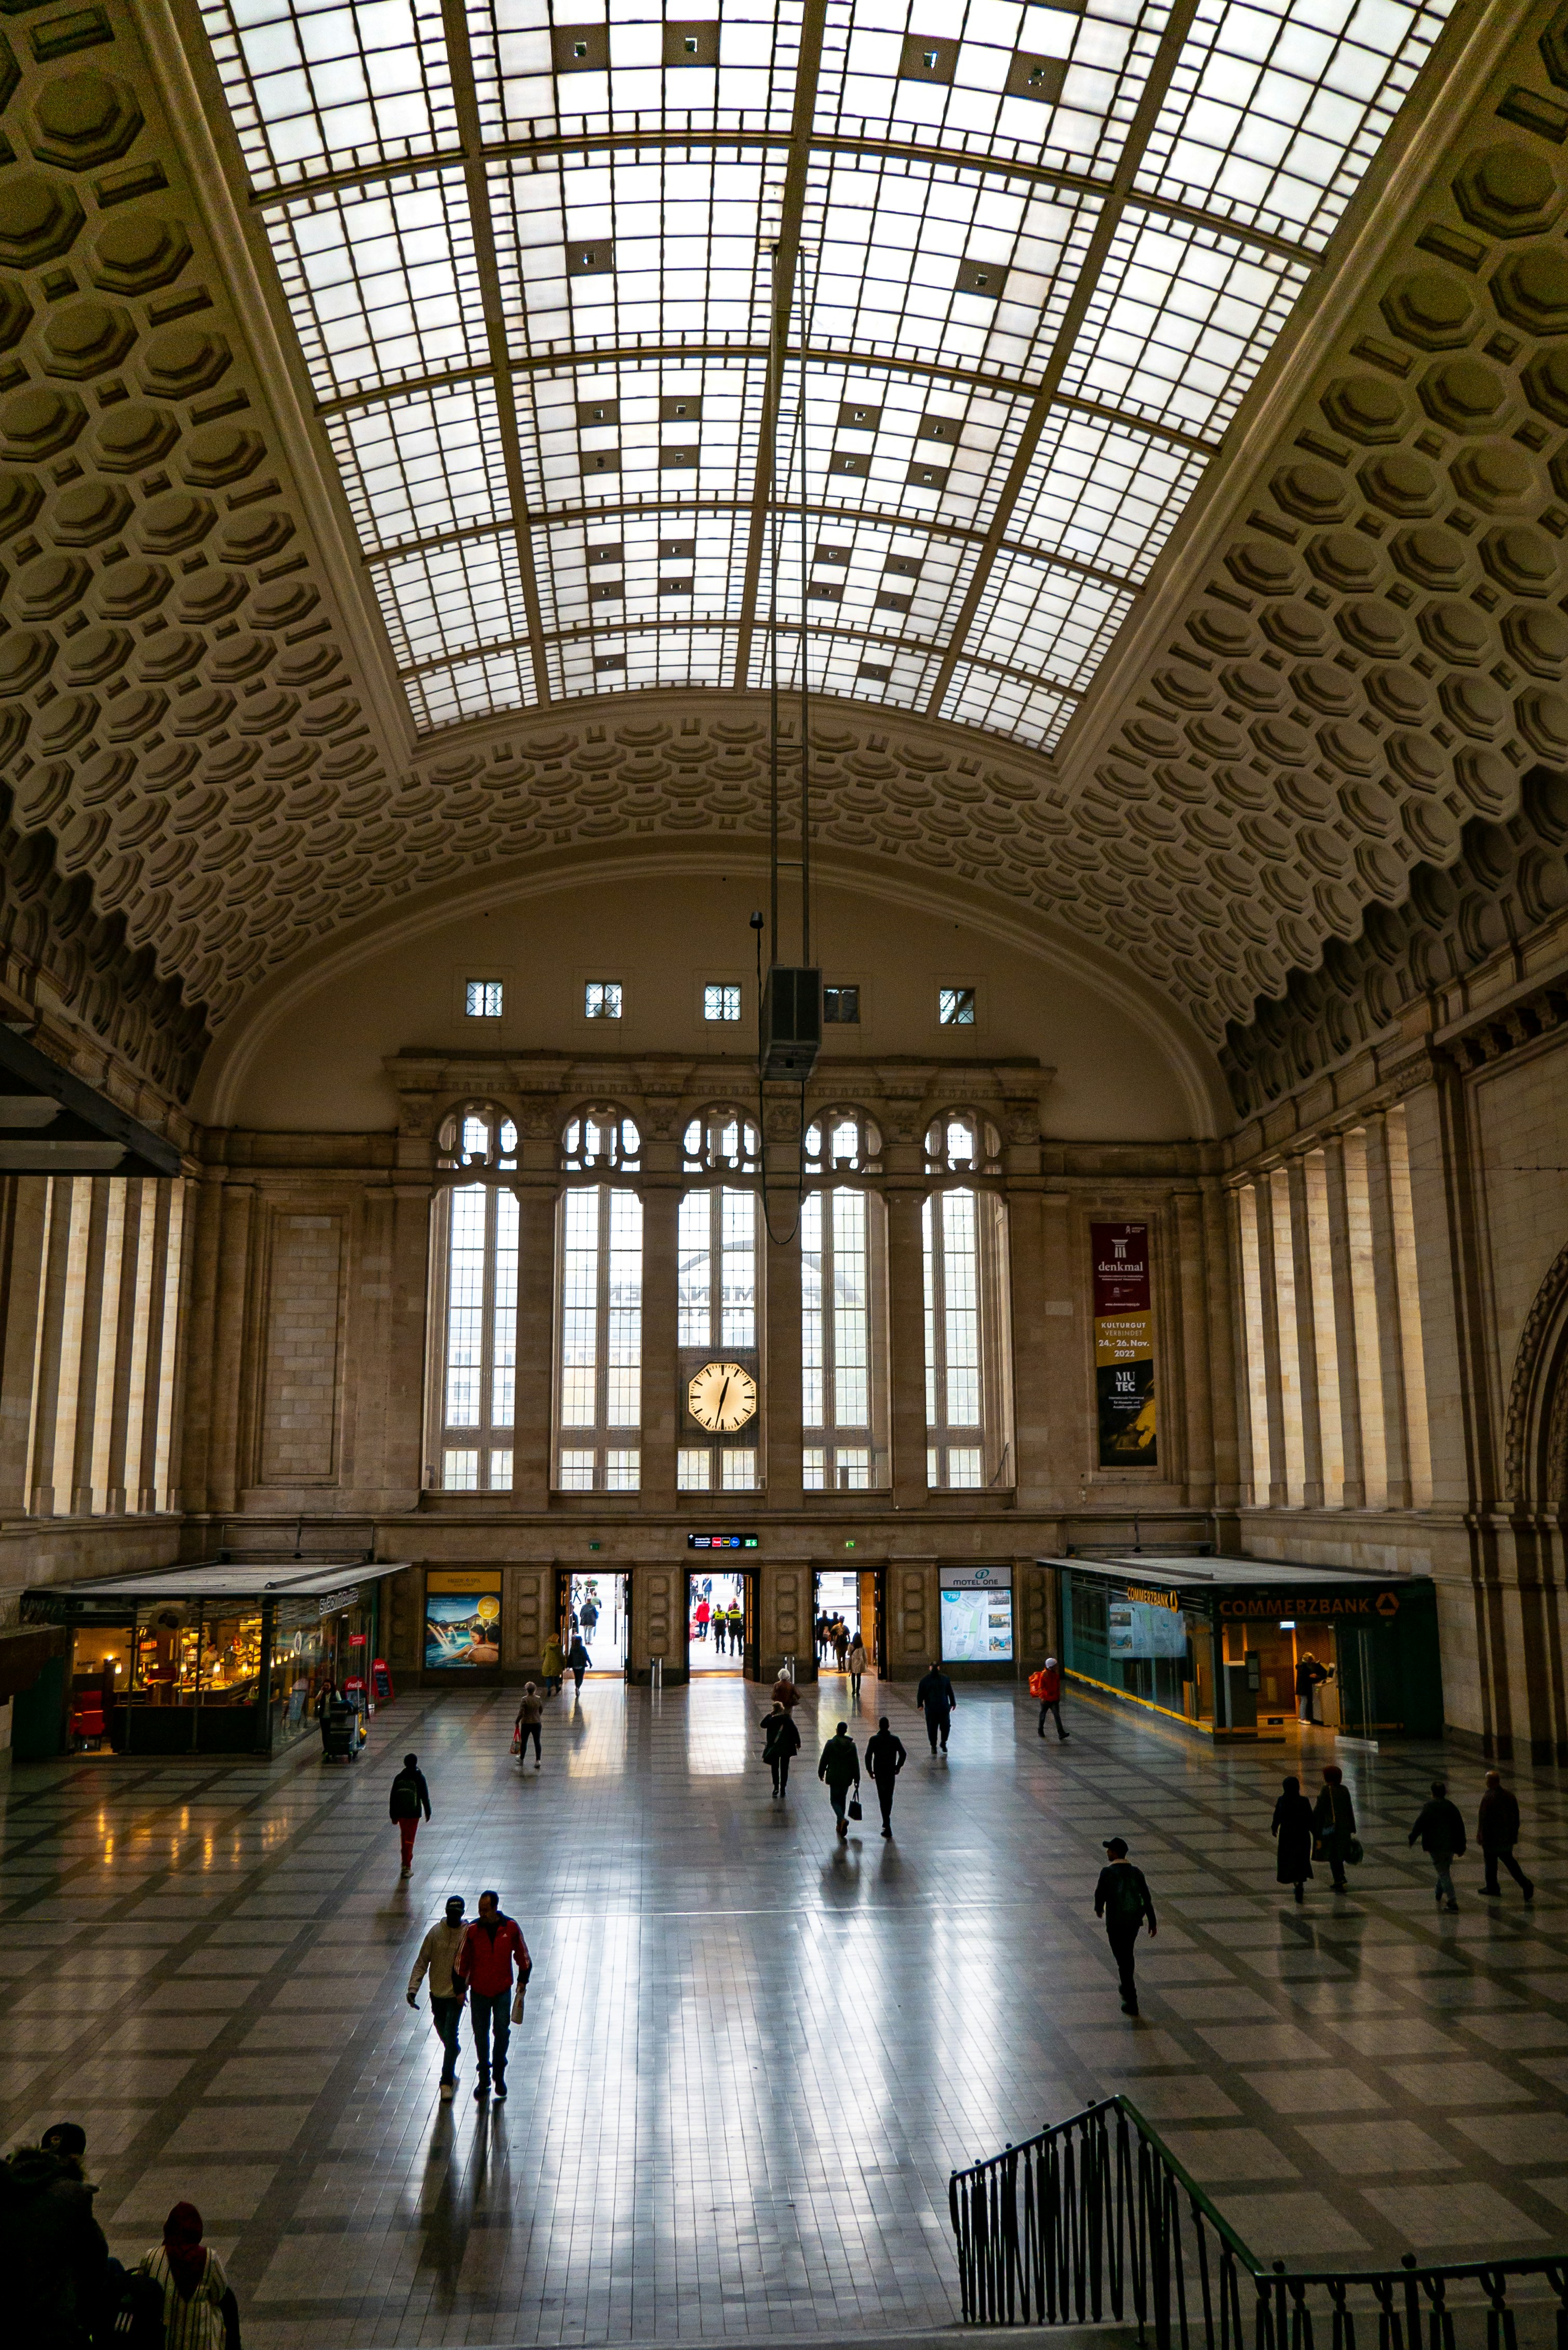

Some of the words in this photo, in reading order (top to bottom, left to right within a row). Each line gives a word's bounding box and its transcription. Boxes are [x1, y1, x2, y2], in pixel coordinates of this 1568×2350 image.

[1098, 1261, 1143, 1271] denkmal
[1116, 1371, 1135, 1382] MU
[1116, 1382, 1136, 1392] TEC
[1127, 1586, 1170, 1609] COMMERZBANK
[1219, 1598, 1371, 1615] COMMERZBANK
